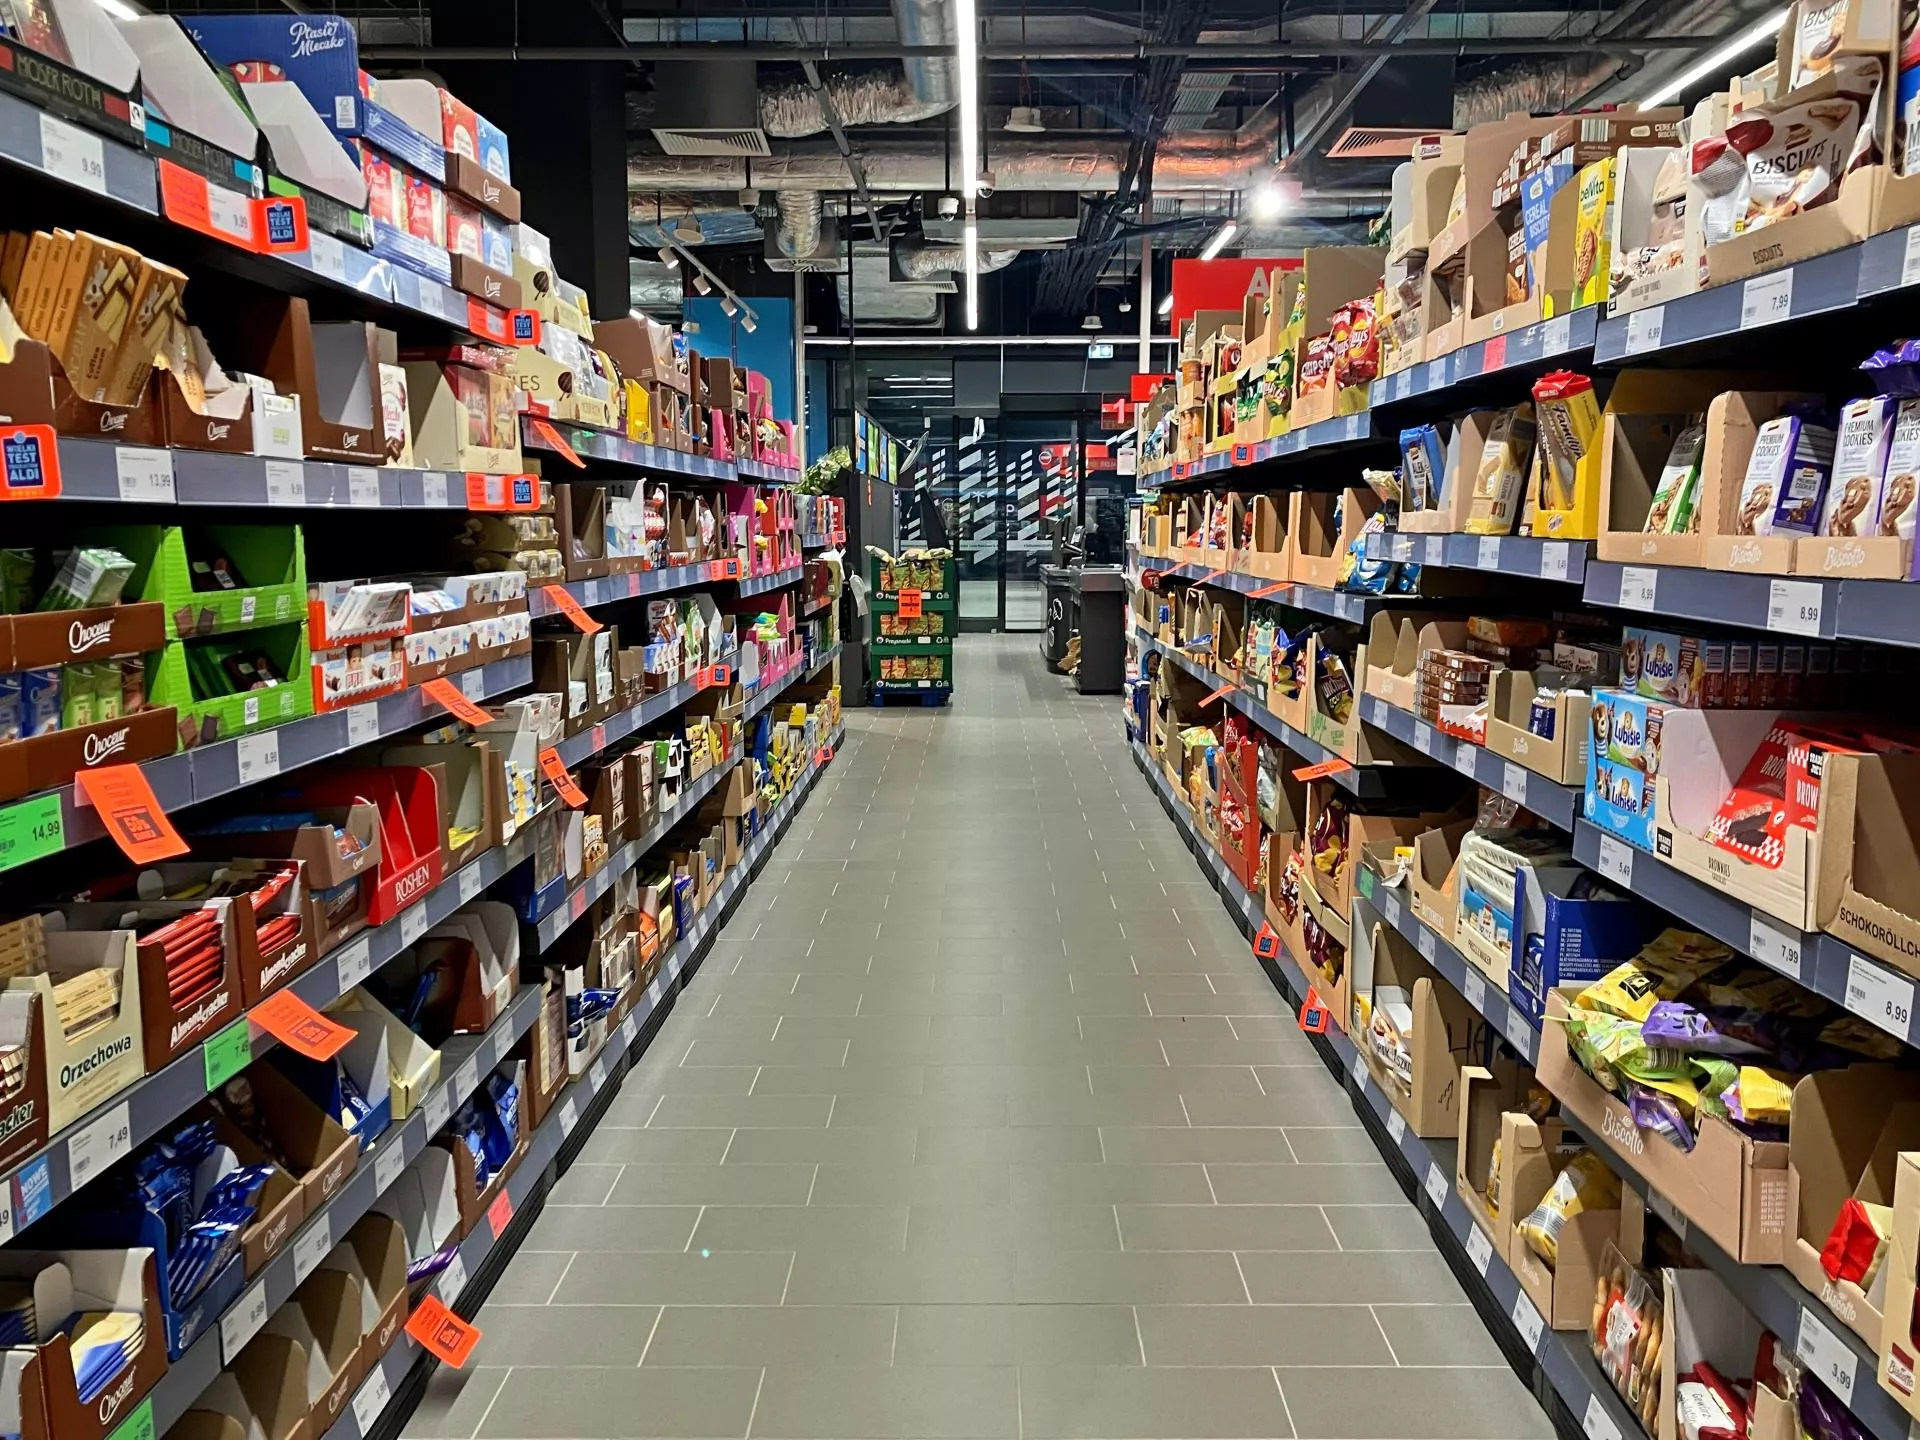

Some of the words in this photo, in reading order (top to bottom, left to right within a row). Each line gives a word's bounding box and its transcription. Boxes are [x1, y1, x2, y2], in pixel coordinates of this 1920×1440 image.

[289, 20, 338, 46] Ptasie
[17, 56, 61, 89] MOSER
[61, 70, 102, 109] ROTH
[270, 217, 292, 227] TEST
[270, 229, 293, 241] ALDI
[1771, 296, 1789, 311] 7,99
[1845, 420, 1875, 433] PREMIUM
[1842, 432, 1874, 447] COOKIES
[8, 452, 37, 464] TEST
[9, 468, 40, 481] ALDI
[1800, 606, 1818, 622] 8,99
[68, 618, 115, 653] Choceur
[1644, 653, 1673, 678] Lubisie
[1614, 719, 1641, 746] Lubisie
[84, 726, 130, 765] Choceur
[1611, 783, 1637, 814] Lubisie
[32, 820, 61, 843] 14,99
[1618, 862, 1631, 877] 5,49
[394, 865, 430, 904] ROSHEN
[1781, 945, 1799, 965] 7,99
[1885, 999, 1908, 1024] 8,99
[60, 1035, 132, 1088] Orzechowa
[109, 1126, 129, 1151] 7,49
[1601, 1106, 1644, 1156] Biscotto
[1831, 1362, 1852, 1390] 3,99
